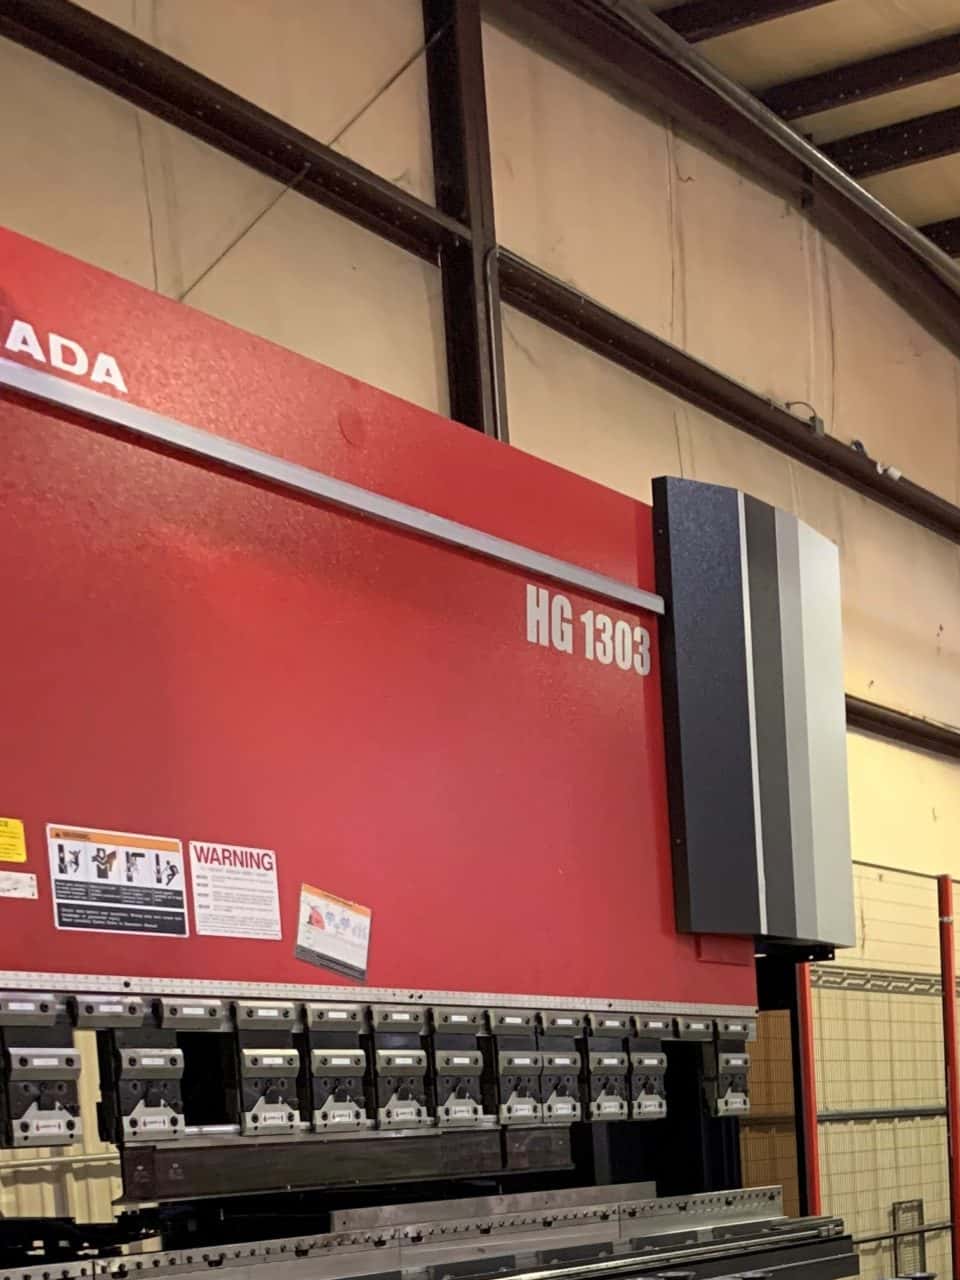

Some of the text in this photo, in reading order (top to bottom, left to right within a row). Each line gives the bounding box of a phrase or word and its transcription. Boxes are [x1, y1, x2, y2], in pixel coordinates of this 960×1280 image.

[5, 319, 128, 394] ADA
[526, 583, 651, 676] HG 1303
[193, 844, 273, 871] WARNING
